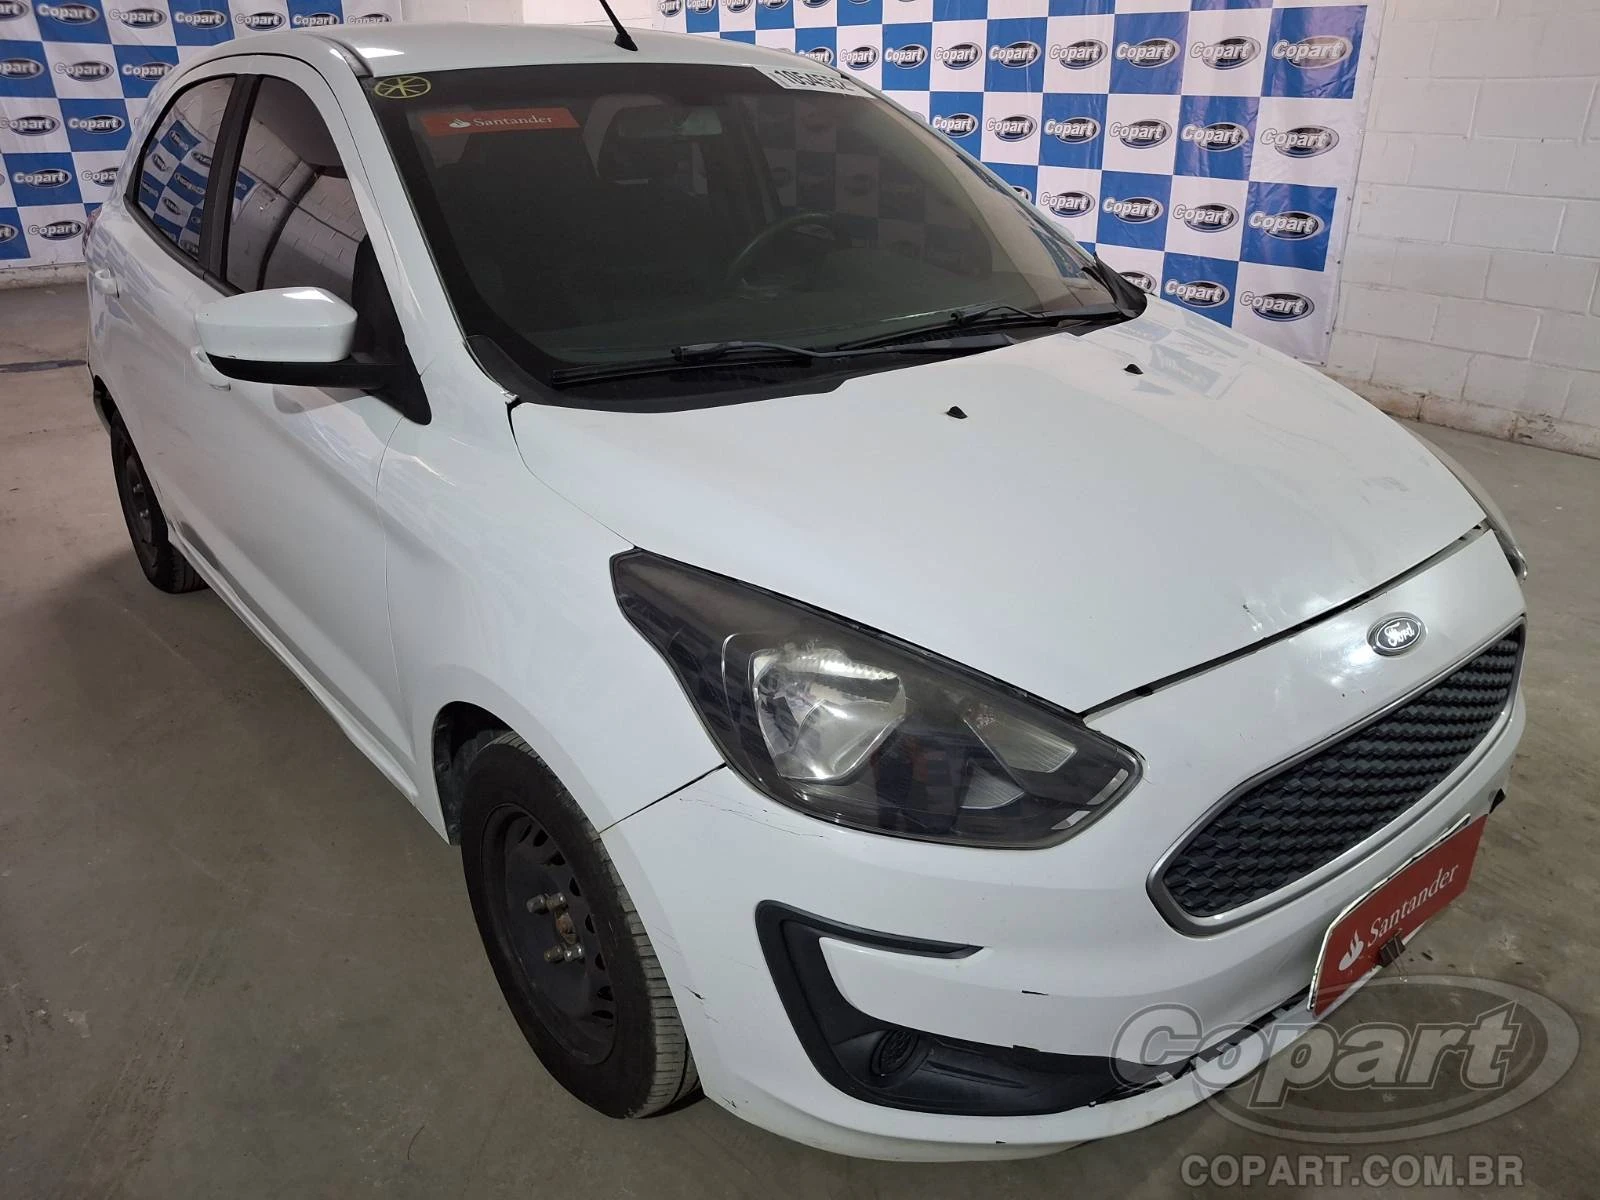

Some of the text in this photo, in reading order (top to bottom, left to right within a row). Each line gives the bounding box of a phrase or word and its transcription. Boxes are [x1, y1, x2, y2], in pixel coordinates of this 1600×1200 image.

[38, 4, 93, 20] Copart
[109, 9, 160, 24] Copart
[175, 11, 222, 26] Copart
[235, 13, 280, 27] Copart
[293, 13, 334, 27] Copart
[840, 48, 874, 64] Copart
[885, 48, 921, 63] Copart
[934, 46, 975, 64] Copart
[988, 46, 1035, 63] Copart
[1049, 44, 1101, 63] Copart
[1116, 42, 1171, 62] Copart
[1190, 41, 1249, 62] Copart
[1272, 40, 1341, 62] Copart
[55, 62, 107, 78] Copart
[69, 117, 118, 131] Copart
[473, 115, 553, 127] Santander
[932, 116, 972, 135] Copart
[986, 117, 1031, 136] Copart
[1044, 119, 1094, 139] Copart
[1109, 121, 1162, 141] Copart
[1181, 123, 1239, 145] Copart
[1260, 129, 1326, 150] Copart
[14, 171, 65, 185] Copart
[81, 170, 117, 184] Copa
[1040, 192, 1089, 210] Copart
[1103, 198, 1156, 217] Copart
[1173, 205, 1231, 227] Copart
[1249, 211, 1314, 235] Copart
[28, 222, 78, 239] Copart
[1165, 280, 1223, 302] Copart
[1240, 291, 1305, 316] Copart
[1384, 622, 1415, 647] Ford
[1367, 864, 1459, 947] Santander
